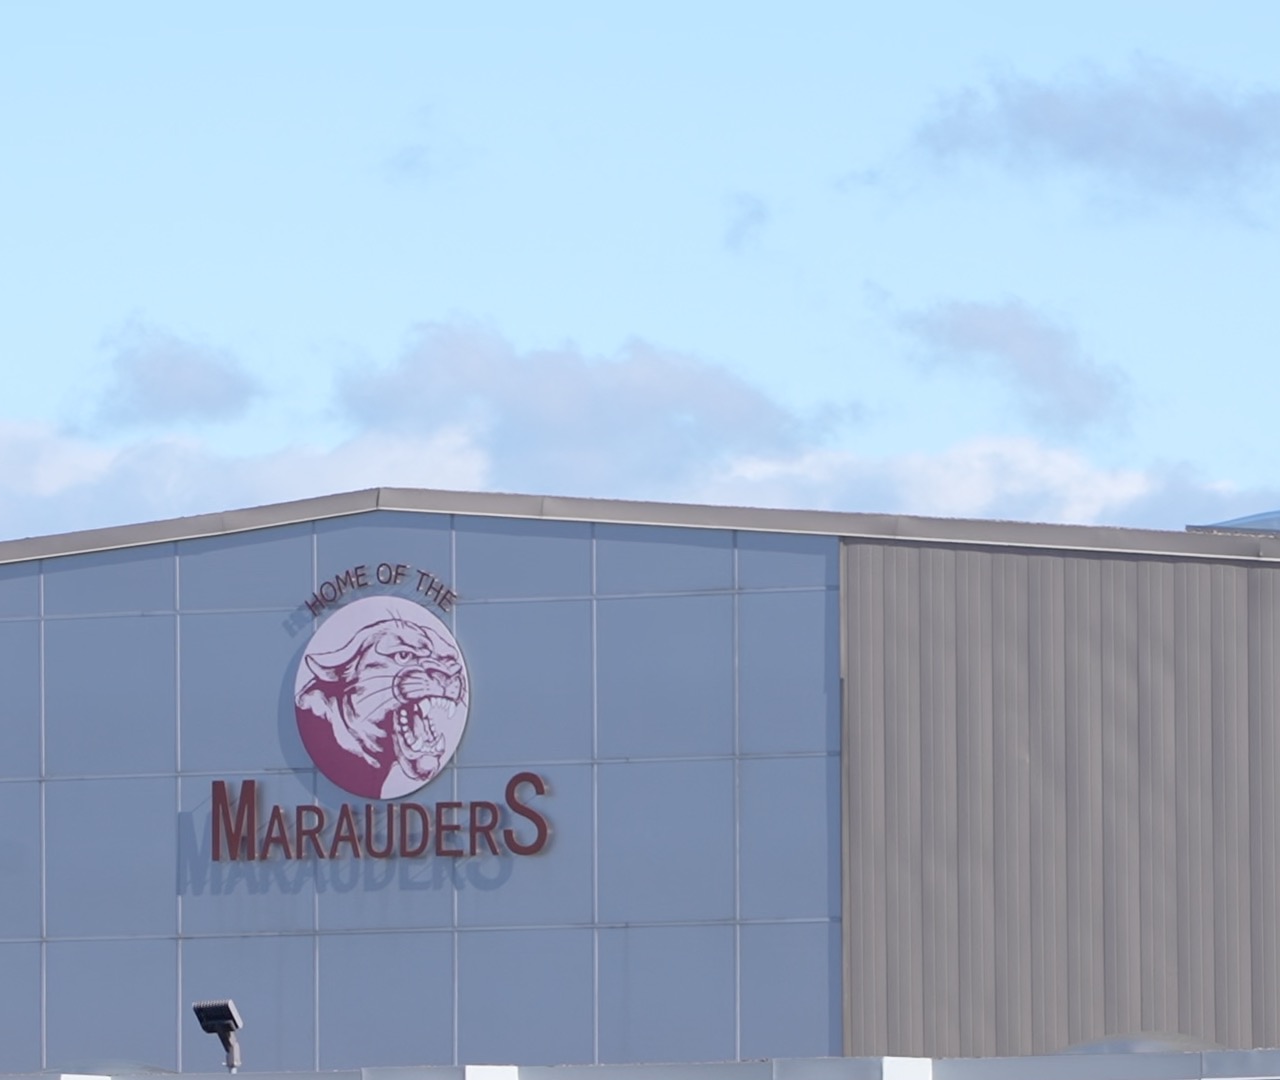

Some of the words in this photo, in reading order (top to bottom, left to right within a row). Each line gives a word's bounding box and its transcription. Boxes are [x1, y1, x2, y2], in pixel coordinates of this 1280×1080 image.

[304, 565, 369, 617] HOME
[376, 563, 408, 585] OF
[416, 569, 458, 612] THE
[211, 772, 549, 862] MARAUDERS
